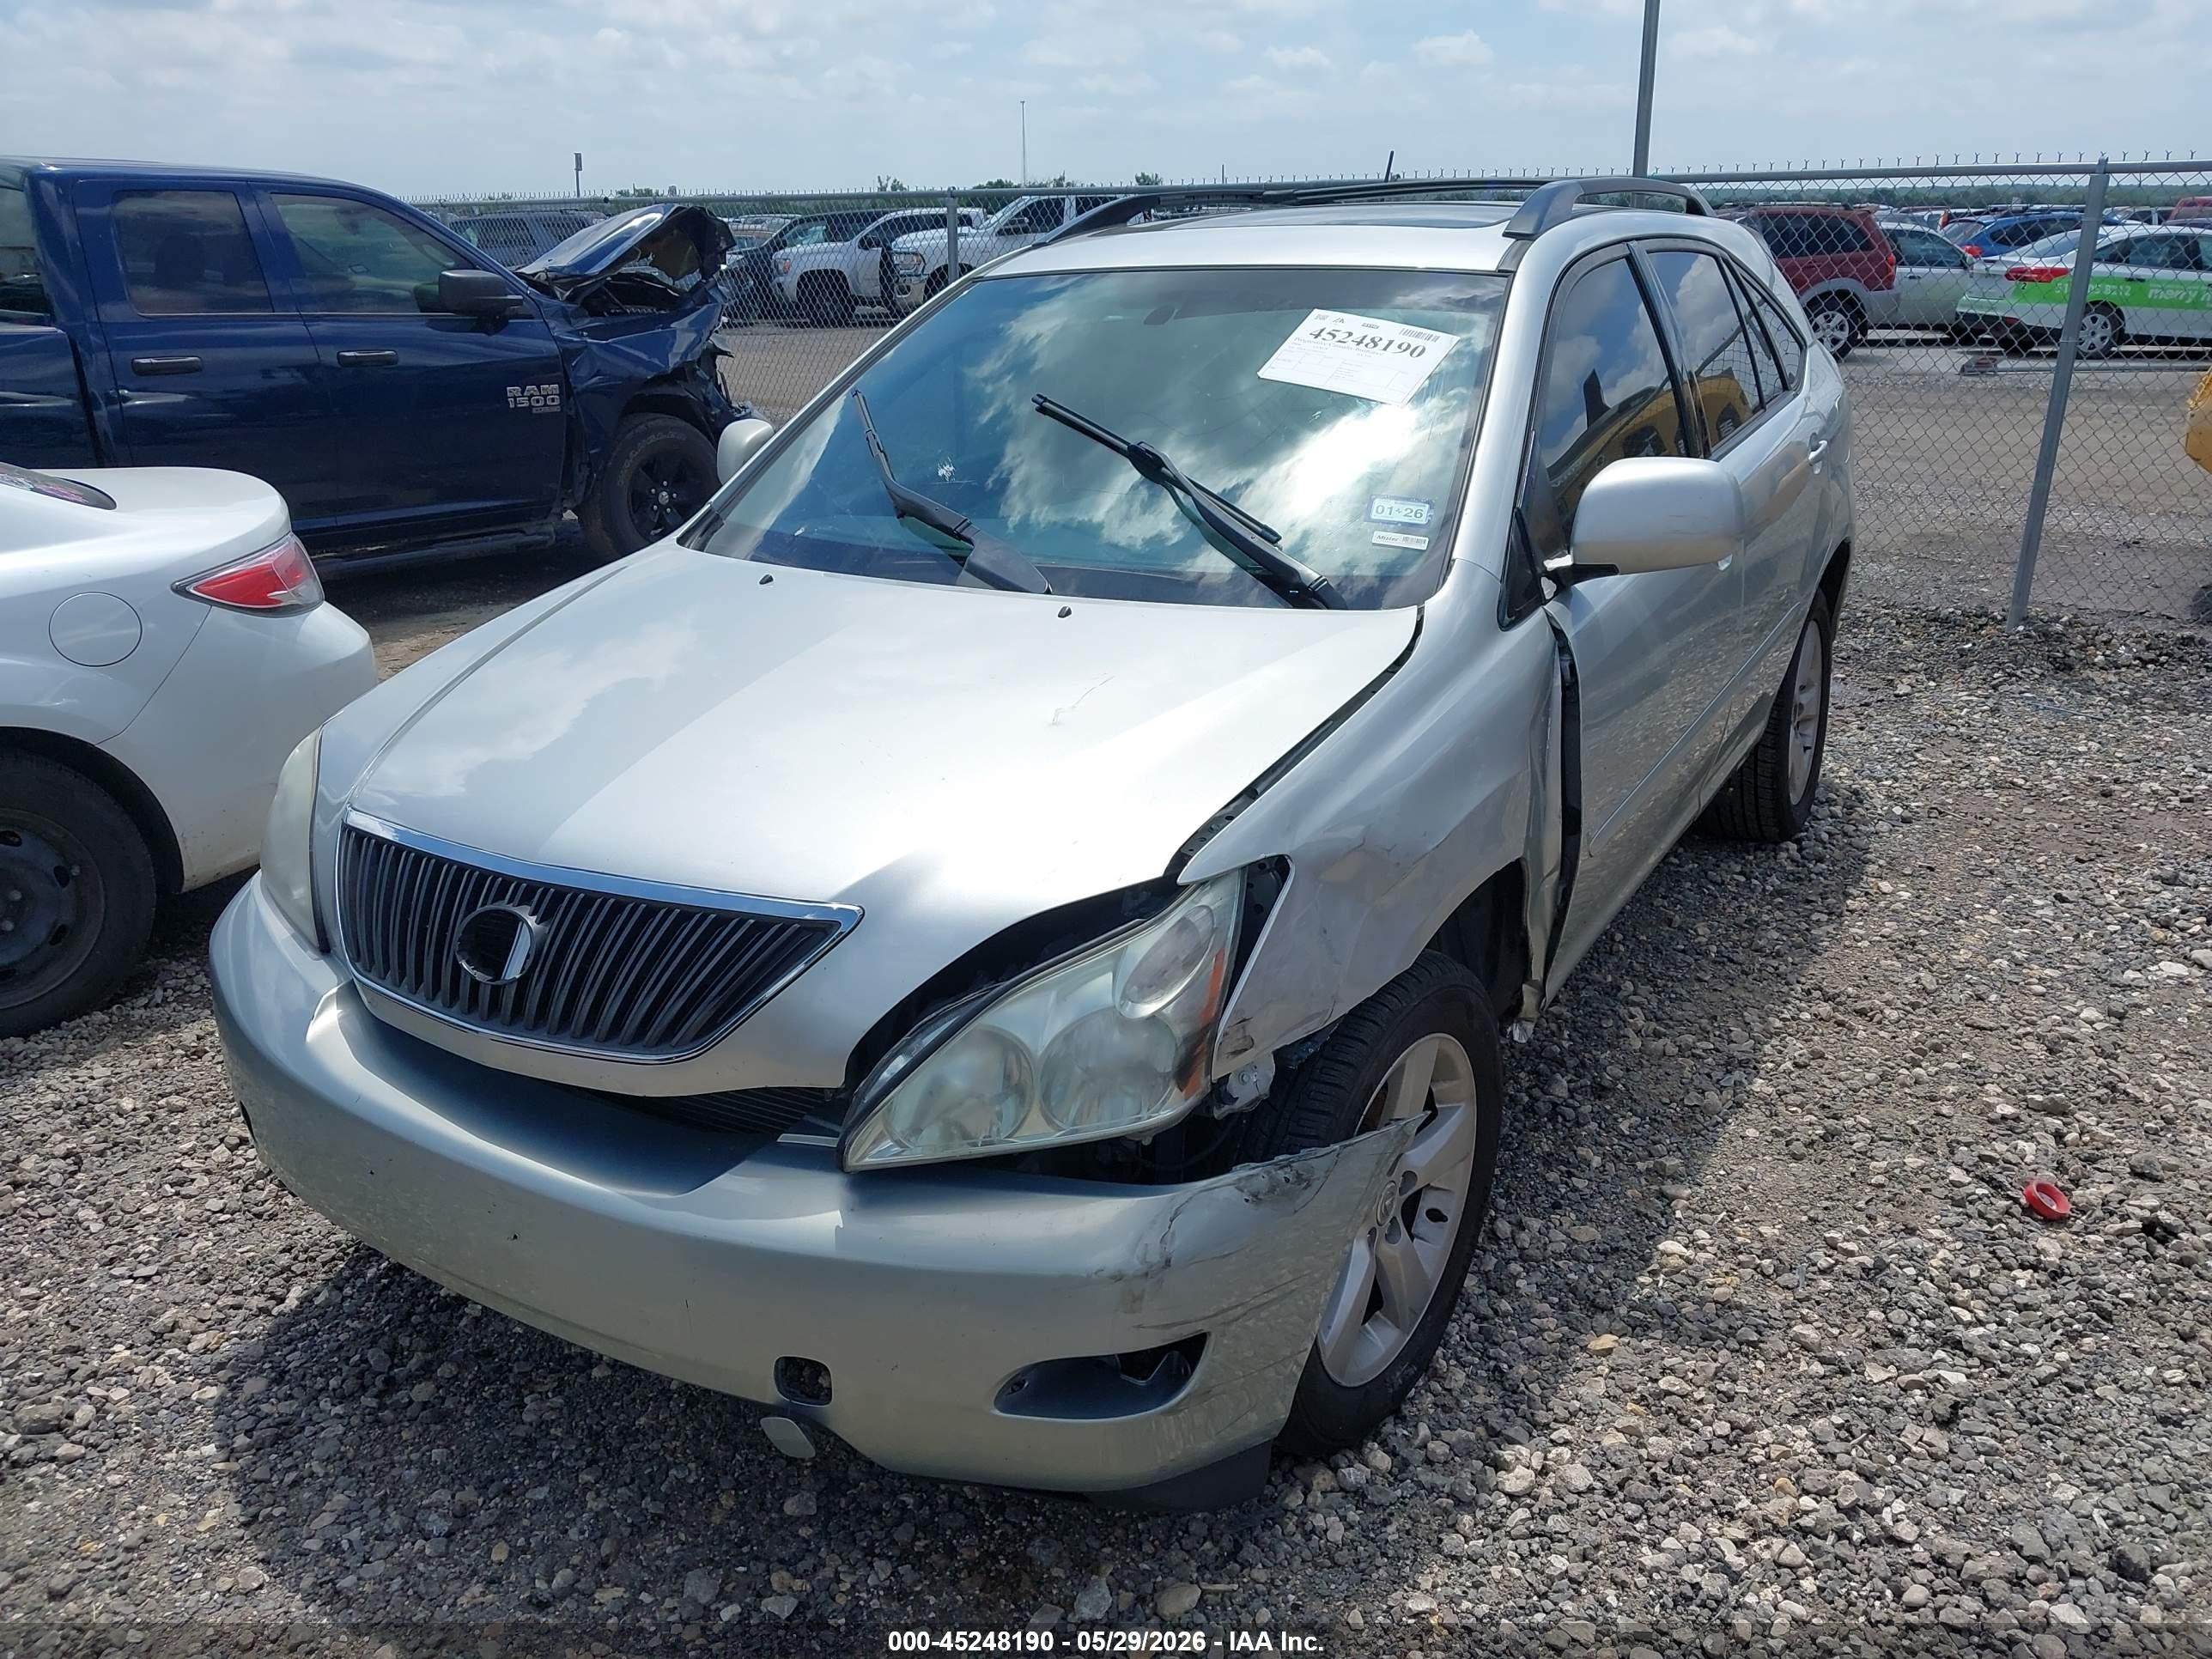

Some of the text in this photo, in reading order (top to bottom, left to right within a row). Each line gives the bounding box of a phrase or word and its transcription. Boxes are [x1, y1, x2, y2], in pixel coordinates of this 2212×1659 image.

[1309, 326, 1426, 358] 45248190
[507, 384, 559, 397] RAM
[507, 395, 560, 408] 1500
[1375, 504, 1394, 515] 01
[1402, 507, 1424, 519] 26
